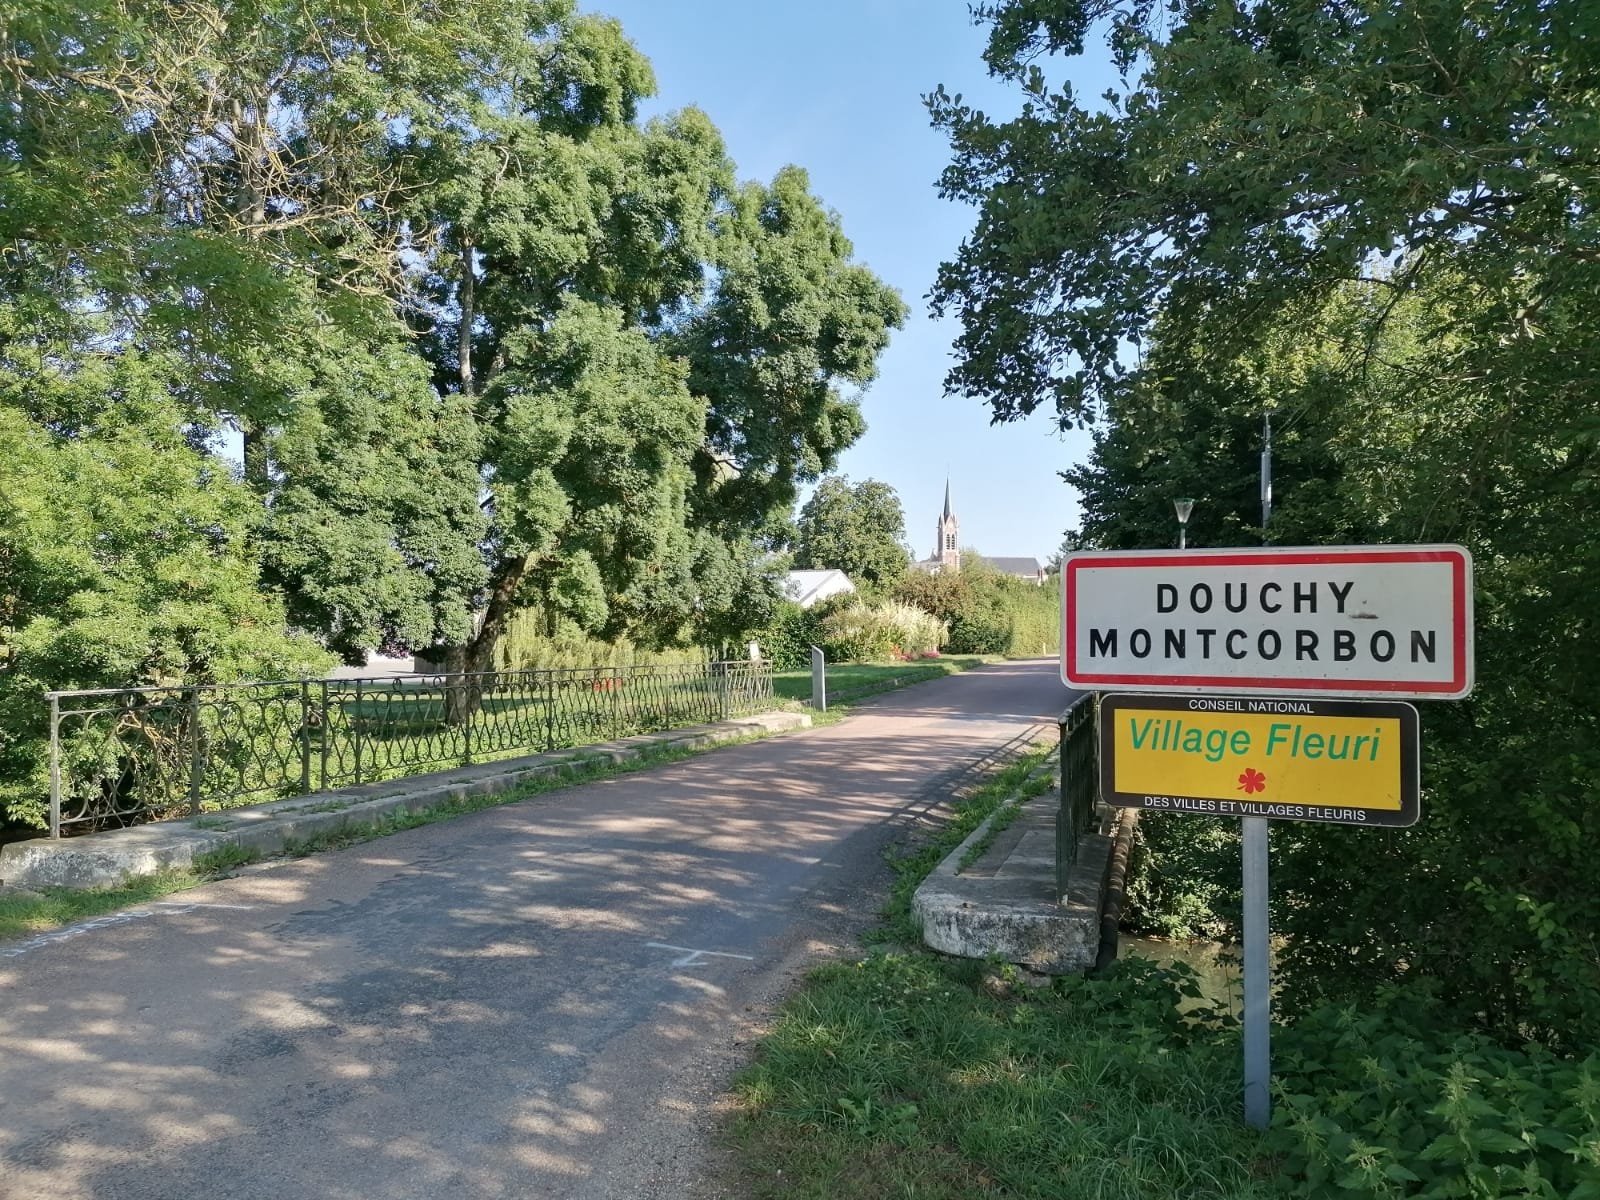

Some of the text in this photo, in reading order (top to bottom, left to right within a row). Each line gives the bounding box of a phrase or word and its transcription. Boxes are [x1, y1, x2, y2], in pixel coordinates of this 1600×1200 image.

[1157, 582, 1355, 614] DOUCHY
[1089, 628, 1436, 664] MONTCORBON
[1188, 699, 1315, 714] CONSEIL NATIONAL
[1129, 718, 1381, 762] Village Fleuri
[1144, 795, 1367, 821] DES VILLES ET VILLAGES FLEURIS
